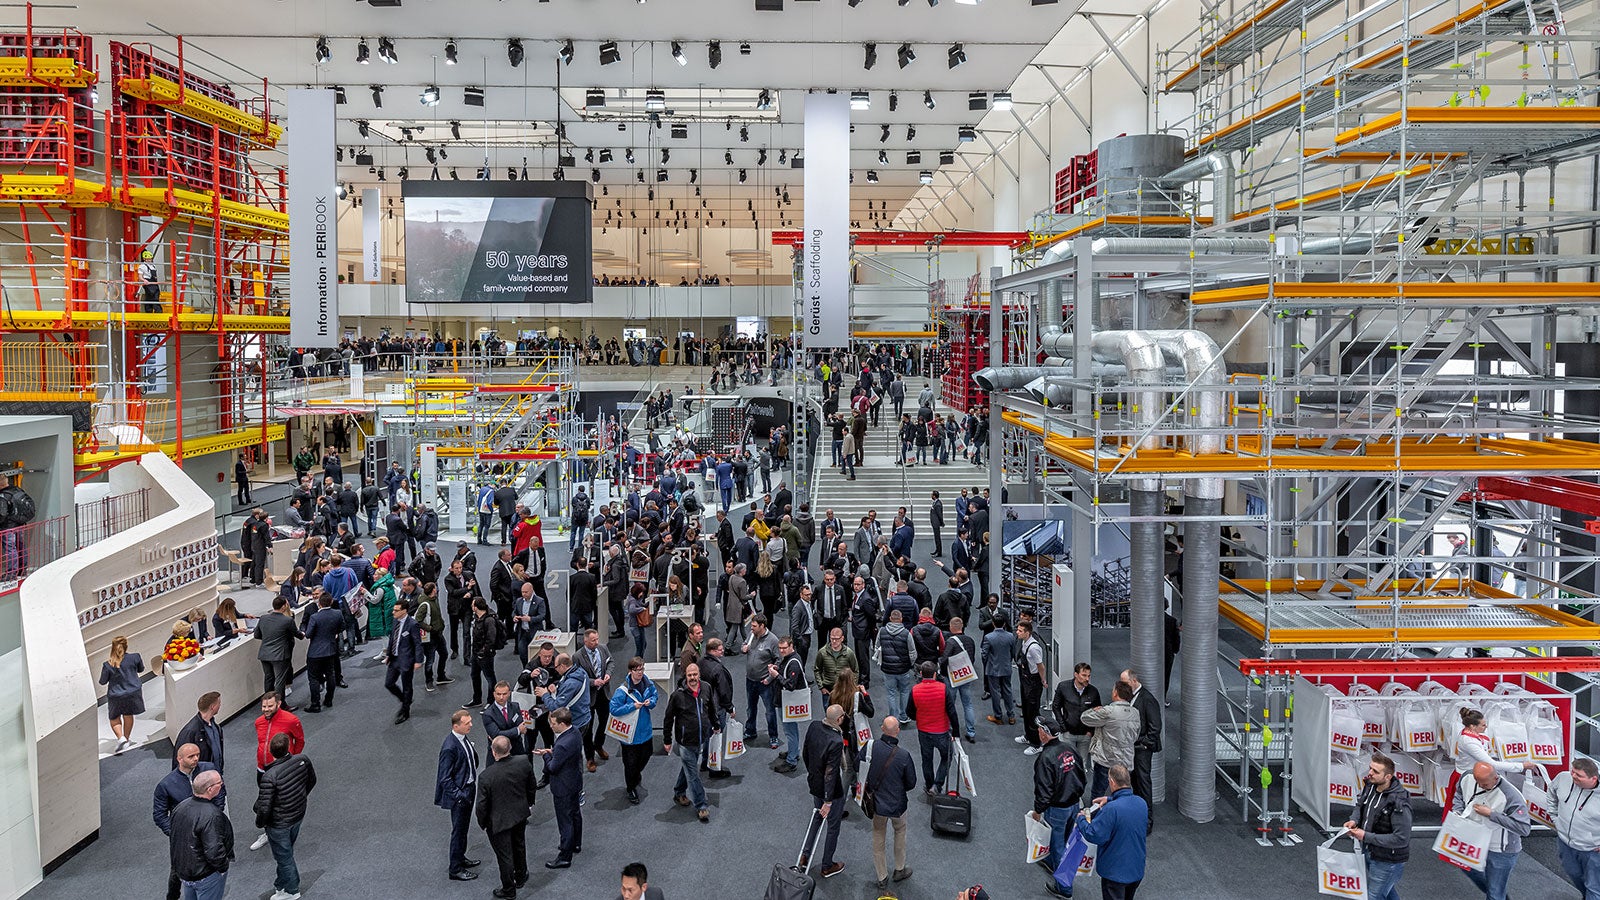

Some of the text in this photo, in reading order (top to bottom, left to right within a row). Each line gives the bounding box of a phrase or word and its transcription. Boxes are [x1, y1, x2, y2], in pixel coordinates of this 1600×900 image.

[316, 196, 328, 336] Information PERIBOOK
[486, 251, 568, 272] 50 years
[507, 273, 568, 282] Value-based and
[809, 229, 823, 335] Gerüst Scaffolding
[483, 284, 568, 293] family-owned company
[610, 504, 618, 517] 6
[689, 515, 698, 529] 5
[582, 533, 594, 549] 4
[672, 550, 682, 564] 3
[547, 572, 560, 589] 2
[633, 569, 647, 578] PERI
[952, 666, 972, 680] PERI
[789, 703, 808, 714] PERI
[611, 718, 631, 735] PERI
[1333, 733, 1358, 747] PERI
[1413, 731, 1434, 743] PERI
[732, 741, 742, 751] PE
[1506, 742, 1527, 755] PERI
[1534, 744, 1557, 756] PERI
[1395, 771, 1419, 785] PERI
[1330, 783, 1352, 797] PERI
[1448, 836, 1482, 860] PERI
[1329, 872, 1361, 890] PERI
